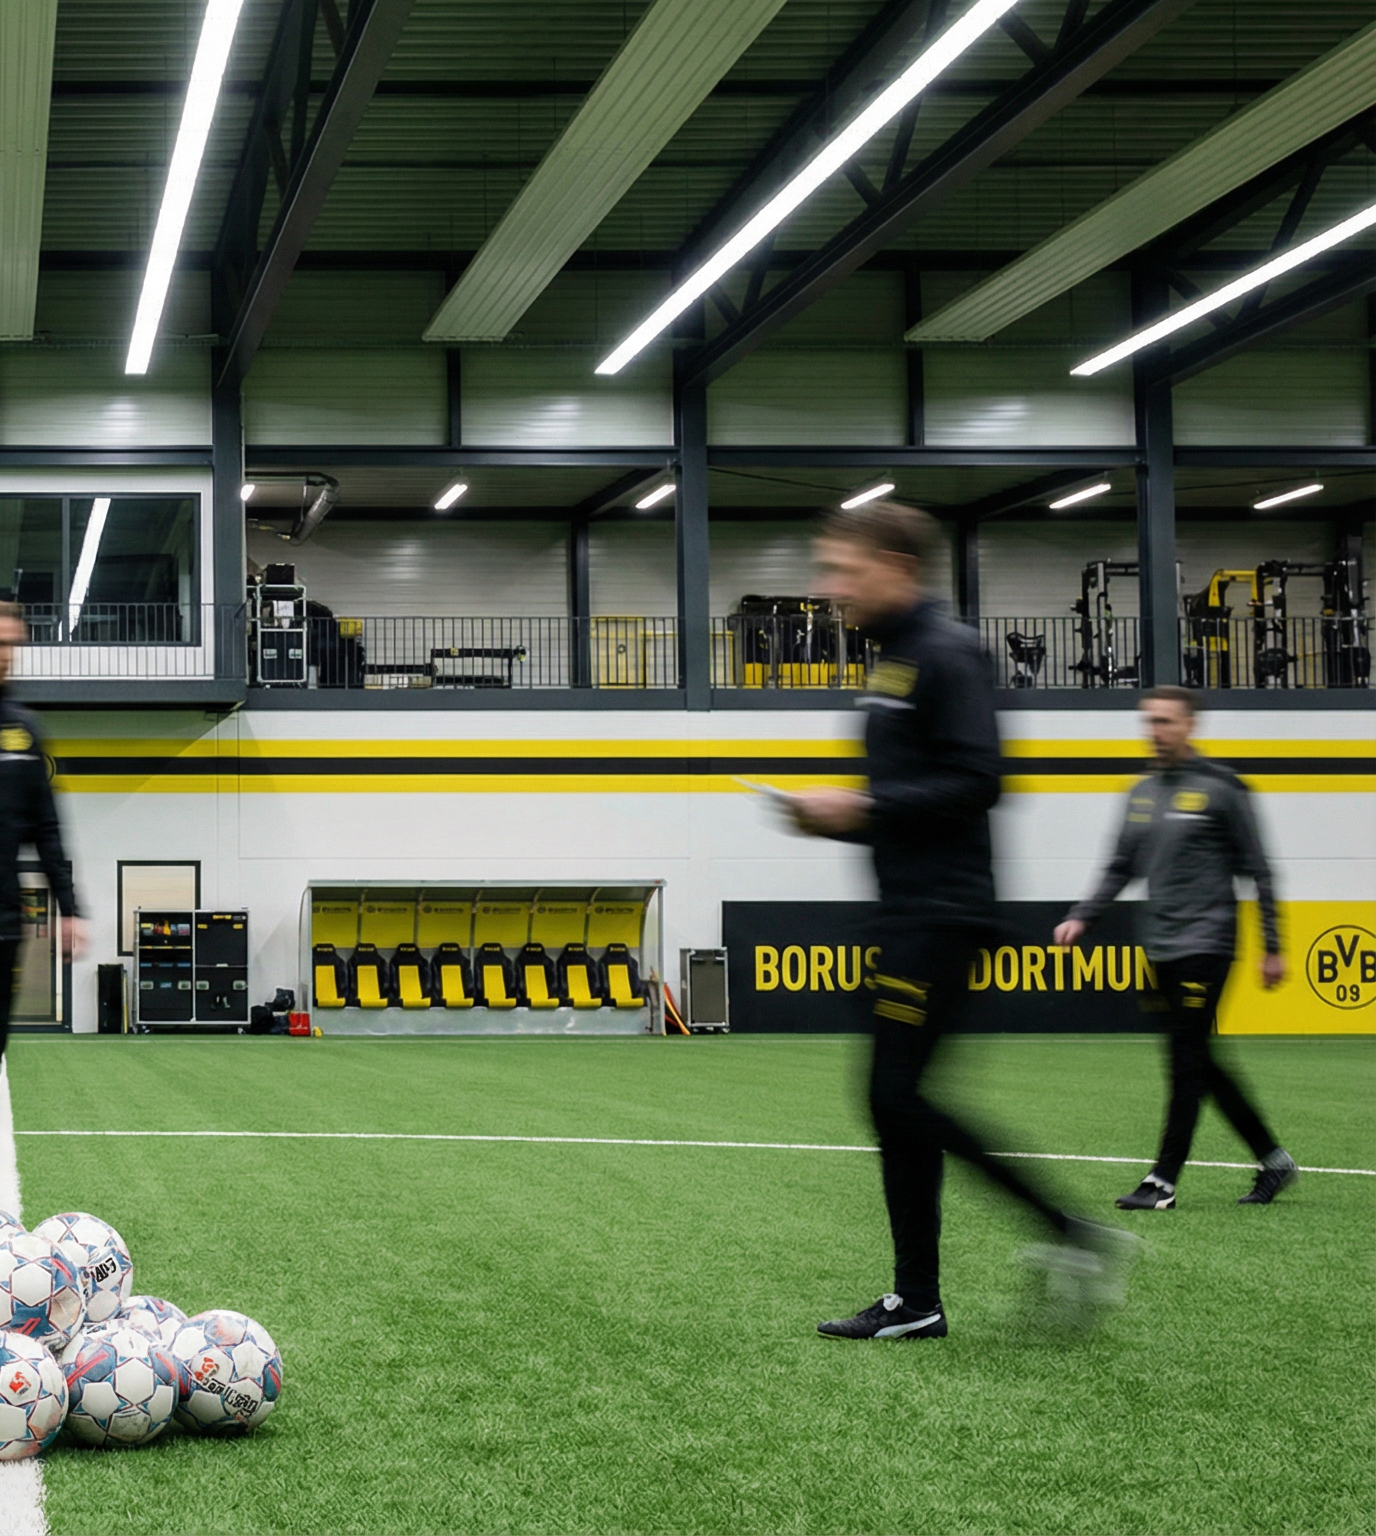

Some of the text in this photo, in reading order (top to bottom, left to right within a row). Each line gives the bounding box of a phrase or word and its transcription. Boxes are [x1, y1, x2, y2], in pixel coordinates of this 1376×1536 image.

[967, 945, 1158, 991] DORTMUN
[1317, 934, 1376, 984] BVB
[1336, 984, 1360, 1002] 09
